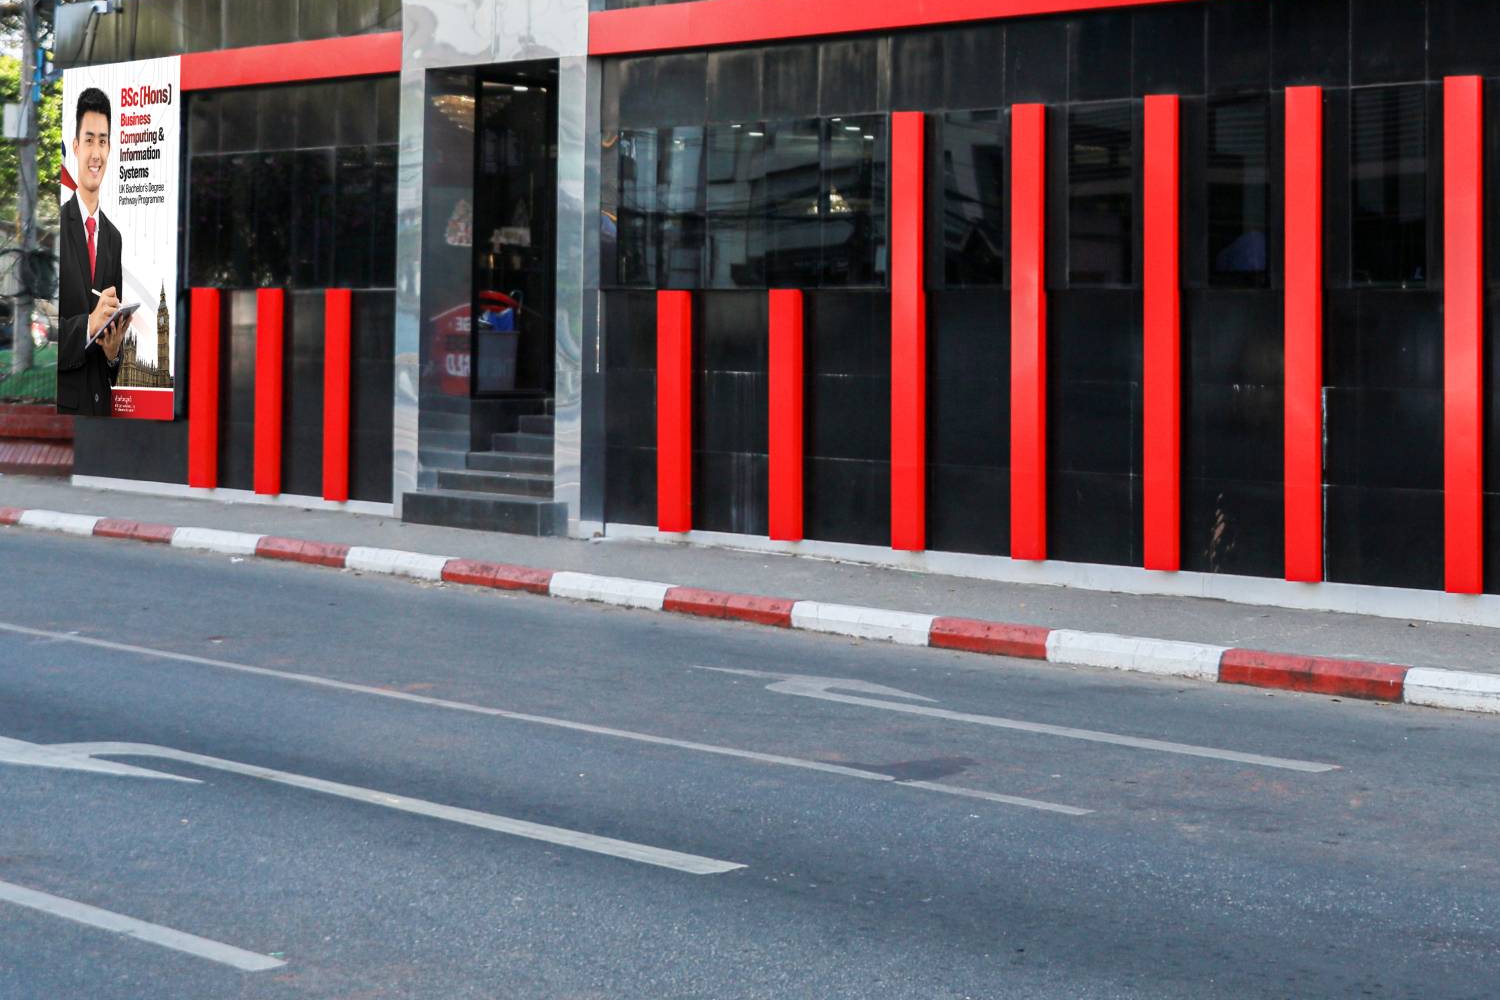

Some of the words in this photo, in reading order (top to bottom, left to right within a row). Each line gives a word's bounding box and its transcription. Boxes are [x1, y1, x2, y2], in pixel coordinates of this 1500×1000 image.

[121, 87, 139, 108] BSc
[140, 83, 172, 108] (Hons)
[121, 112, 152, 127] Business
[120, 129, 158, 146] Computing
[158, 126, 165, 142] &
[120, 146, 161, 162] Information
[119, 165, 149, 182] Systems
[119, 184, 126, 194] UK
[148, 182, 165, 193] Degree
[118, 195, 138, 207] Pathway
[138, 195, 165, 206] Programme
